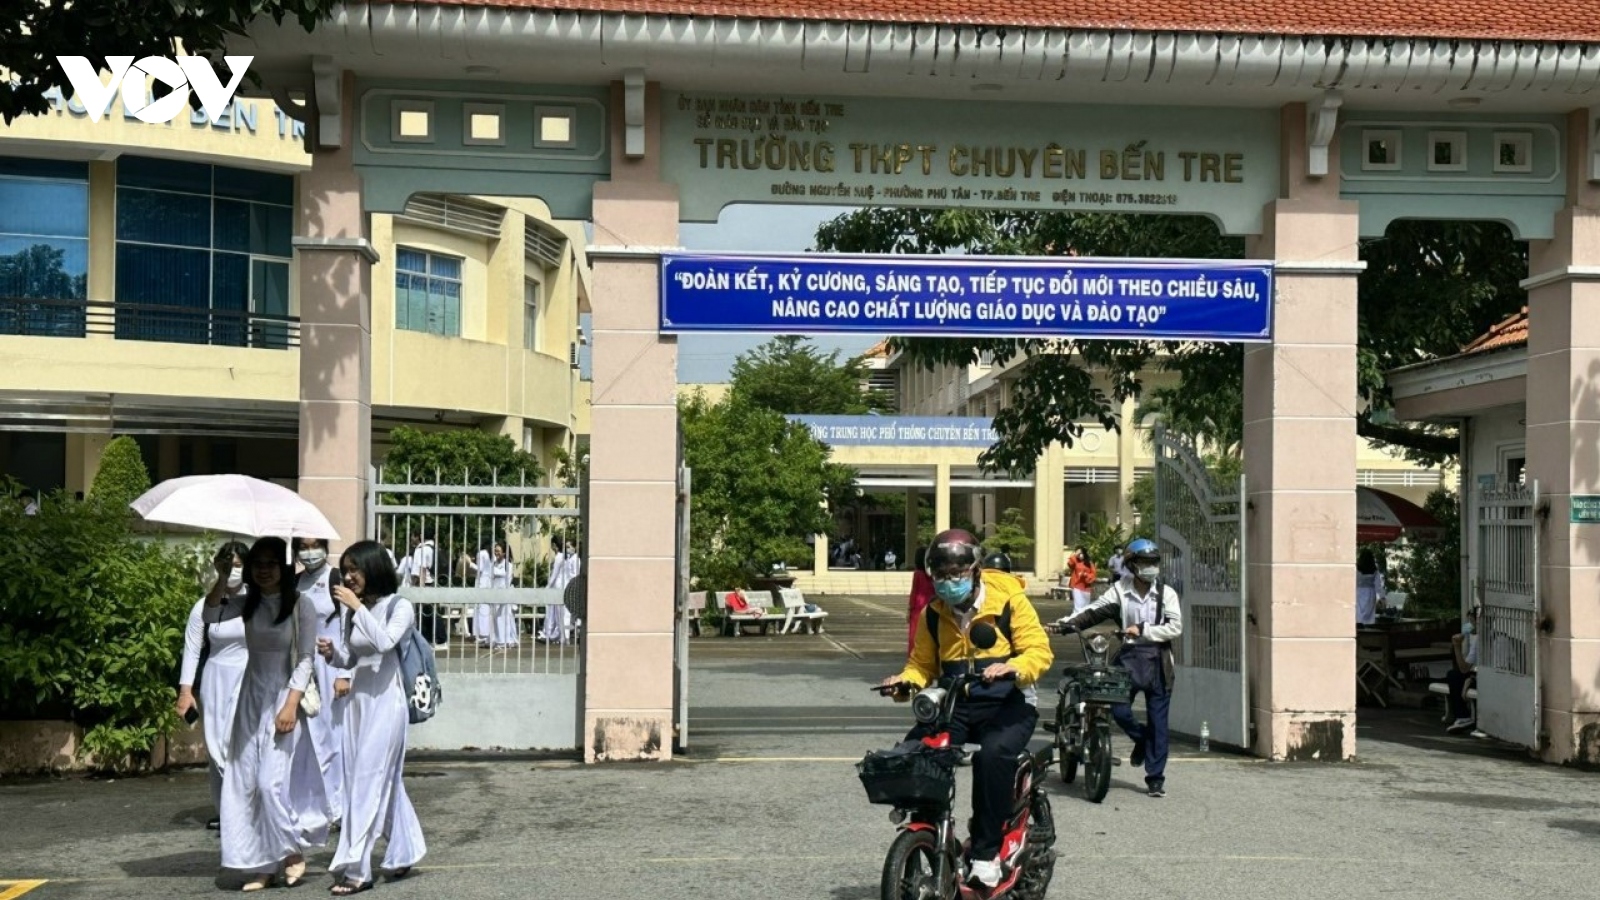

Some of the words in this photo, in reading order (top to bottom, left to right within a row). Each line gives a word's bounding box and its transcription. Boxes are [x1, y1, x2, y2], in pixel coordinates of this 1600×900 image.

[694, 132, 835, 173] TRƯỜNG
[848, 144, 937, 175] THPT
[948, 142, 1086, 179] CHUYÊN
[1100, 140, 1164, 181] BẾN
[1178, 152, 1244, 183] TRE
[771, 181, 806, 196] ĐƯỜNG
[884, 185, 923, 199] PHƯỜNG
[951, 186, 970, 200] TÂN
[1021, 191, 1041, 202] TRE
[674, 268, 729, 291] “ĐOÀN
[734, 266, 774, 294] KẾT,
[778, 267, 802, 291] KỶ
[806, 270, 871, 295] CƯƠNG,
[875, 269, 921, 293] SÁNG
[926, 275, 965, 298] TẠO,
[969, 270, 1007, 295] TIẾP
[1011, 277, 1045, 299] TỤC
[1049, 269, 1078, 296] ĐỔI
[1083, 273, 1113, 296] MỚI
[1118, 279, 1163, 297] THEO
[1167, 273, 1218, 298] CHIỀU
[1222, 278, 1260, 302] SÂU,
[772, 296, 820, 317] NÂNG
[824, 301, 860, 318] CAO
[864, 294, 910, 319] CHẤT
[914, 300, 972, 324] LƯỢNG
[976, 299, 1017, 320] GIÁO
[1021, 303, 1056, 325] DỤC
[1060, 300, 1083, 322] VÀ
[1087, 300, 1121, 322] ĐÀO
[1126, 305, 1166, 327] TẠO”
[830, 425, 858, 440] TRUNG
[860, 426, 877, 442] HỌC
[879, 420, 896, 440] PHỔ
[899, 422, 926, 440] THÔNG
[928, 423, 961, 440] CHUYÊN
[963, 422, 979, 441] BẾN
